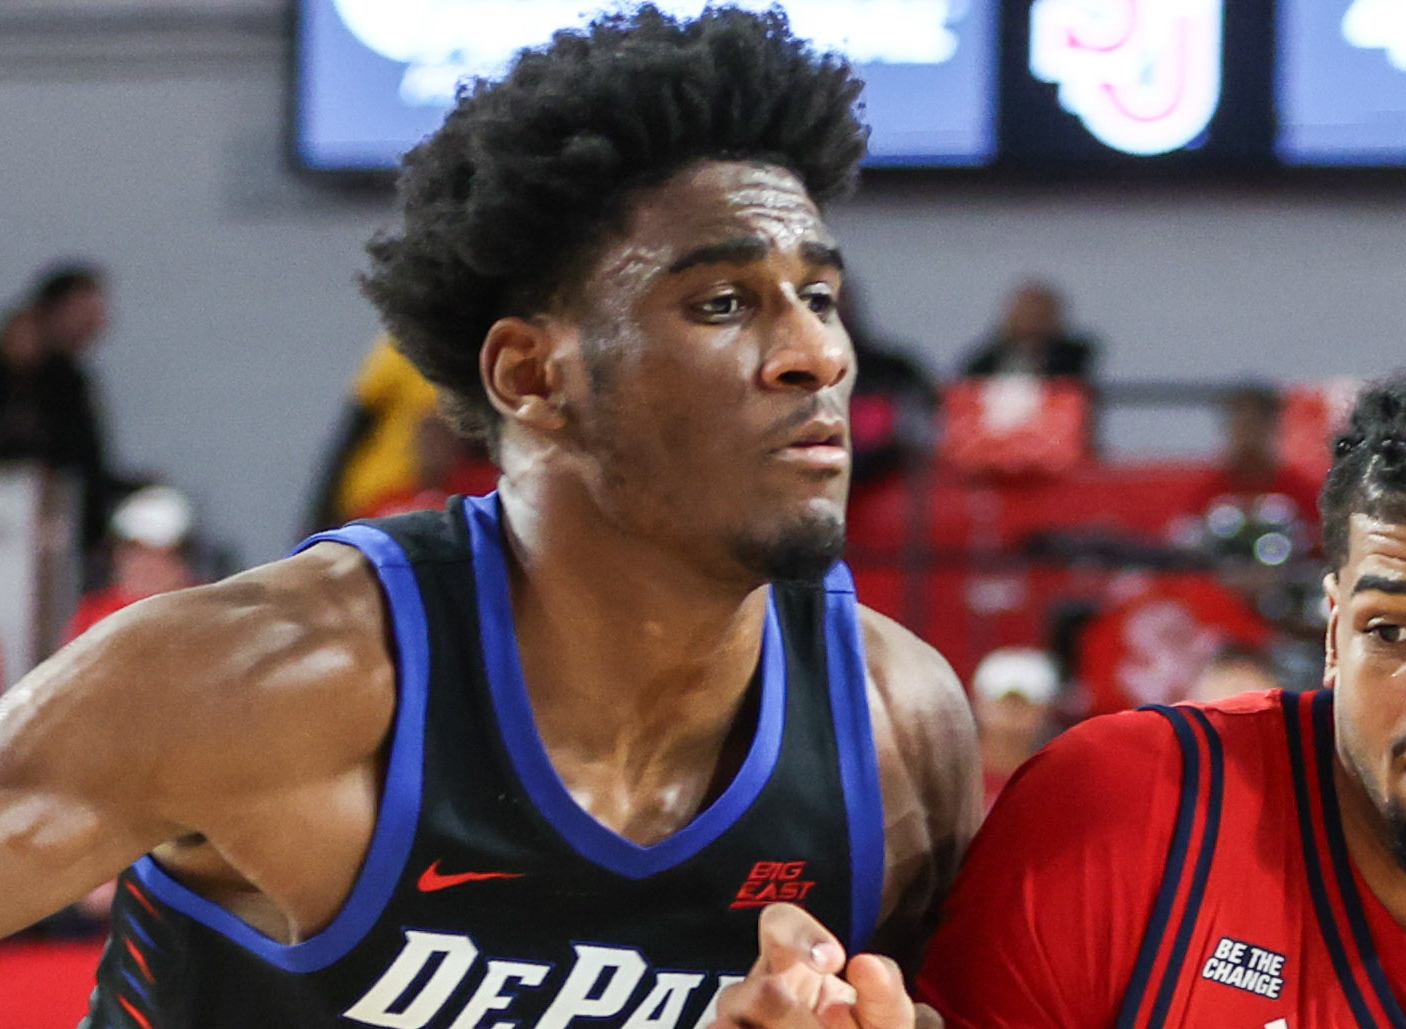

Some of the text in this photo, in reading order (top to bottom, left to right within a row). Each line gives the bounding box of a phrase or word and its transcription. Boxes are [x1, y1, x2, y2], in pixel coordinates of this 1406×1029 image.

[748, 860, 807, 880] BIG
[735, 880, 816, 900] EAST
[1214, 938, 1285, 976] BE THE
[1202, 957, 1284, 998] CHANGE
